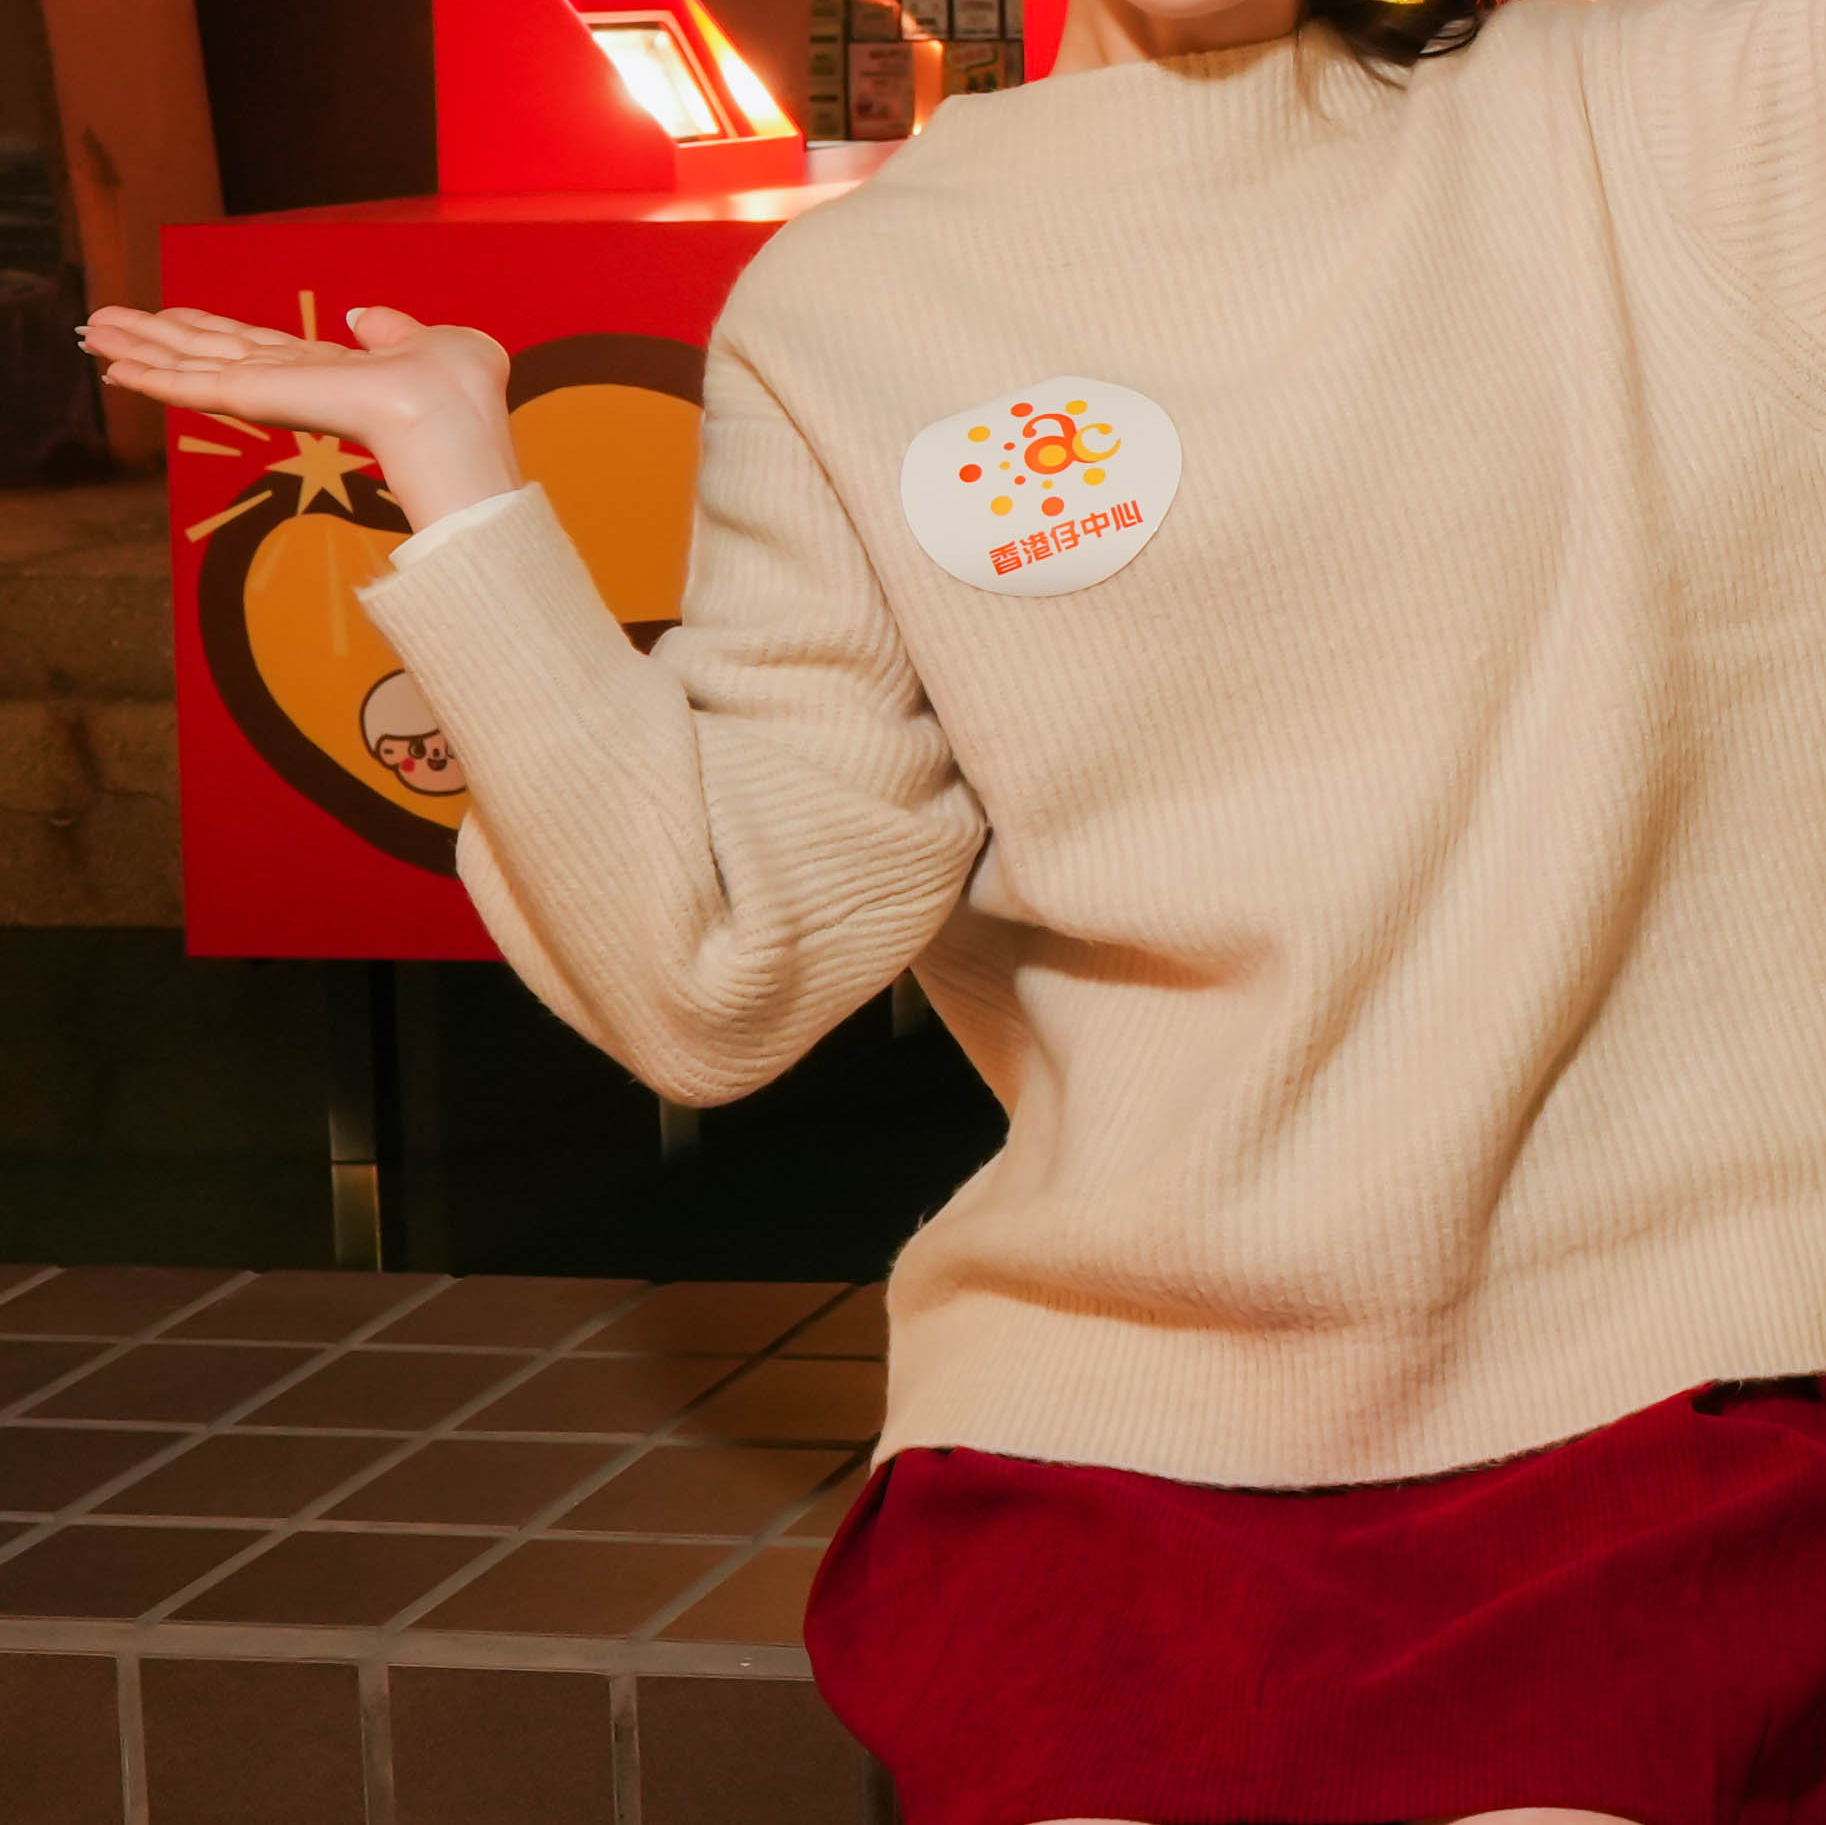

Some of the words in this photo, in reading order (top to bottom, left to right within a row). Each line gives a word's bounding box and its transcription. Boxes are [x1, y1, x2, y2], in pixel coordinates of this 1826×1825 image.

[988, 499, 1145, 577] 香港仔中心
